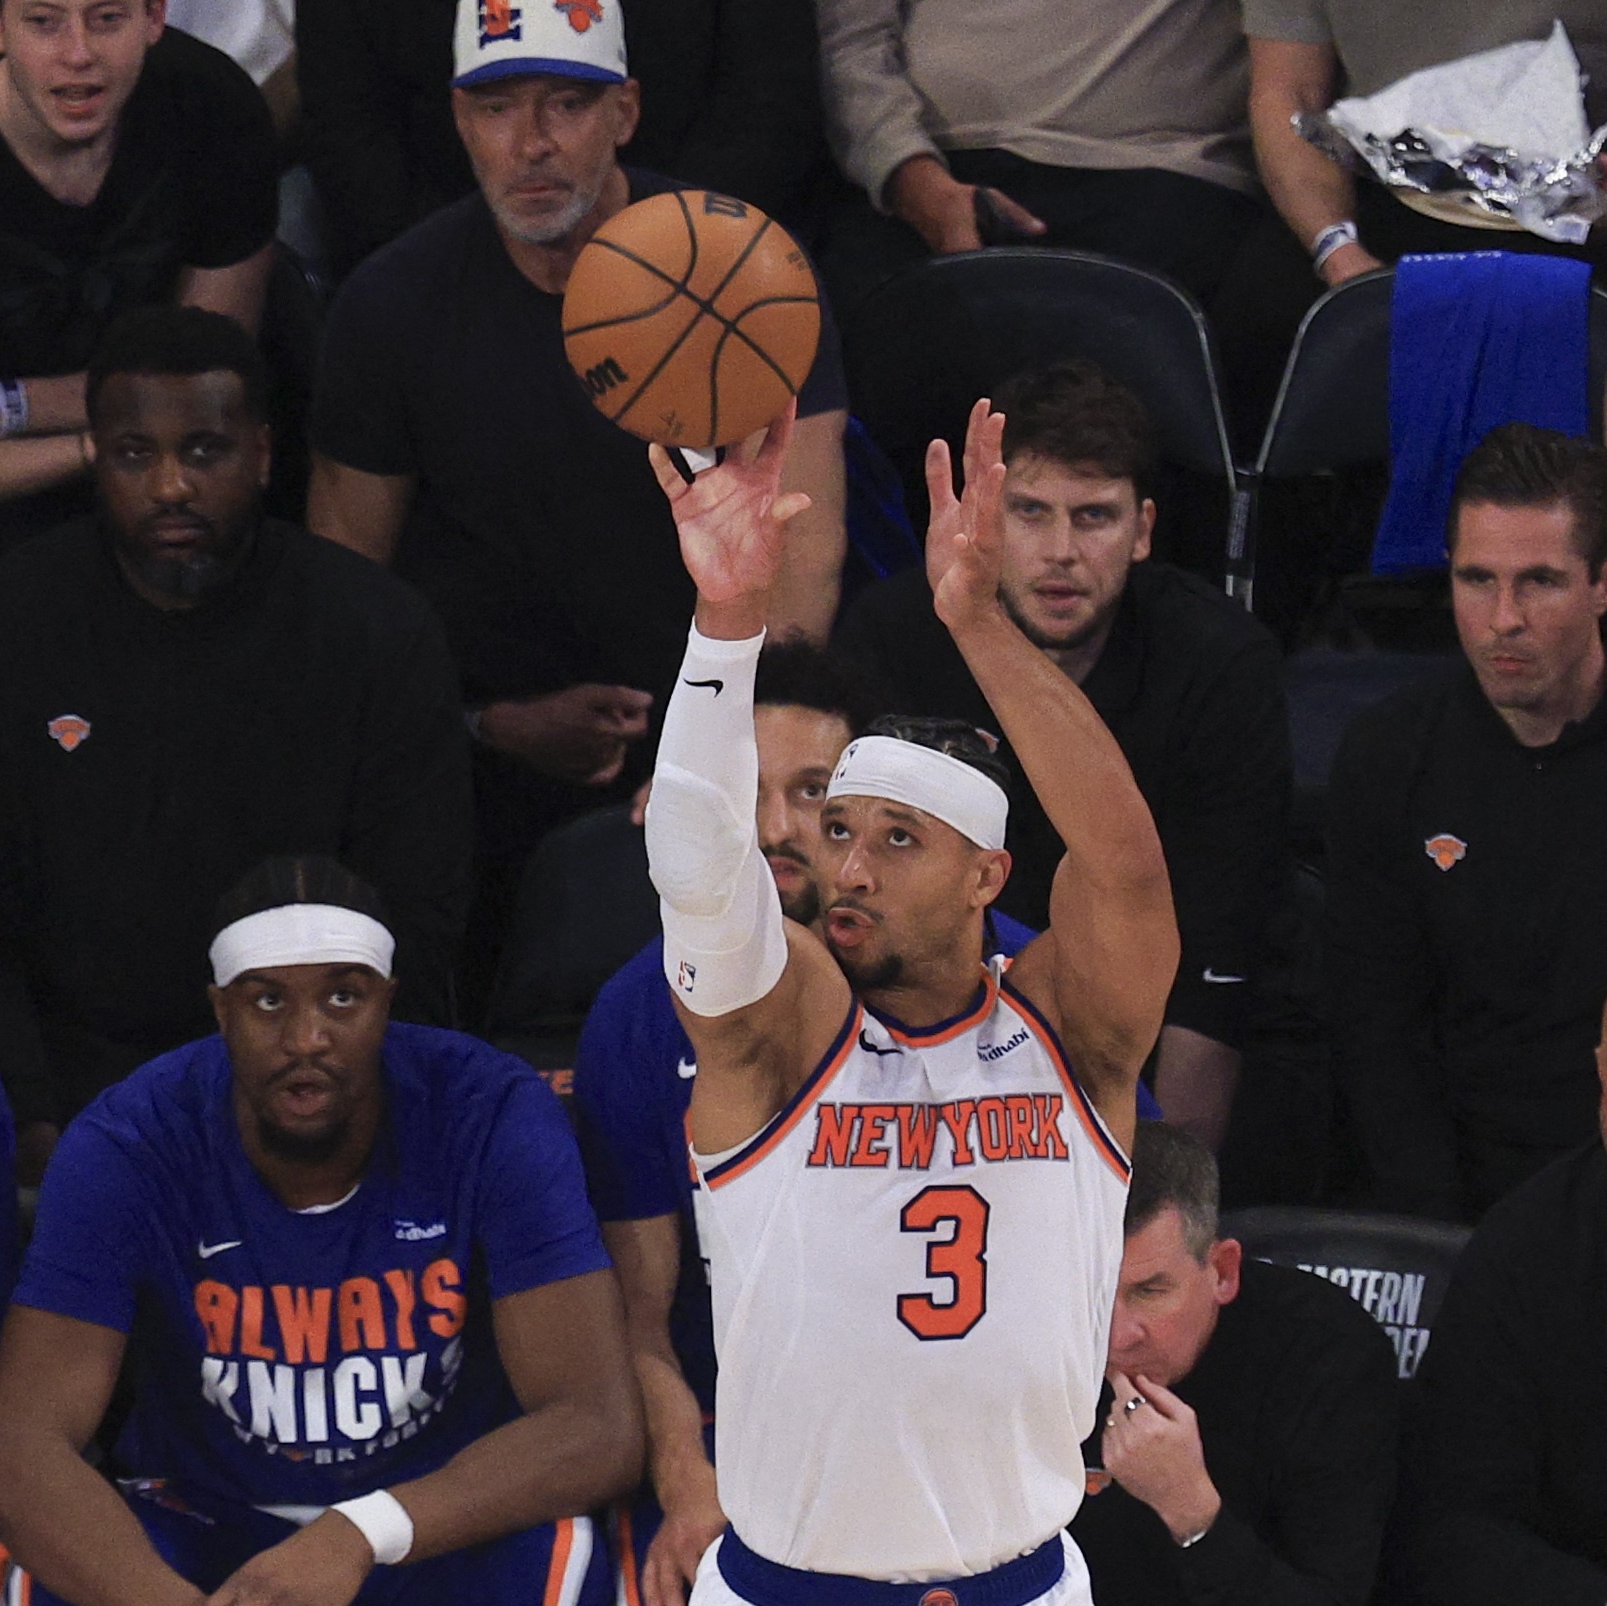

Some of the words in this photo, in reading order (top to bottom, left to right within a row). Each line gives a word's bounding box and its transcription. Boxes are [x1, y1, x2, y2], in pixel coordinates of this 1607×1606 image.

[988, 1027, 1030, 1060] dhabi
[805, 1103, 939, 1170] NEW
[941, 1093, 1070, 1168] YORK
[896, 1184, 990, 1341] 3
[194, 1259, 467, 1364] ALWAYS
